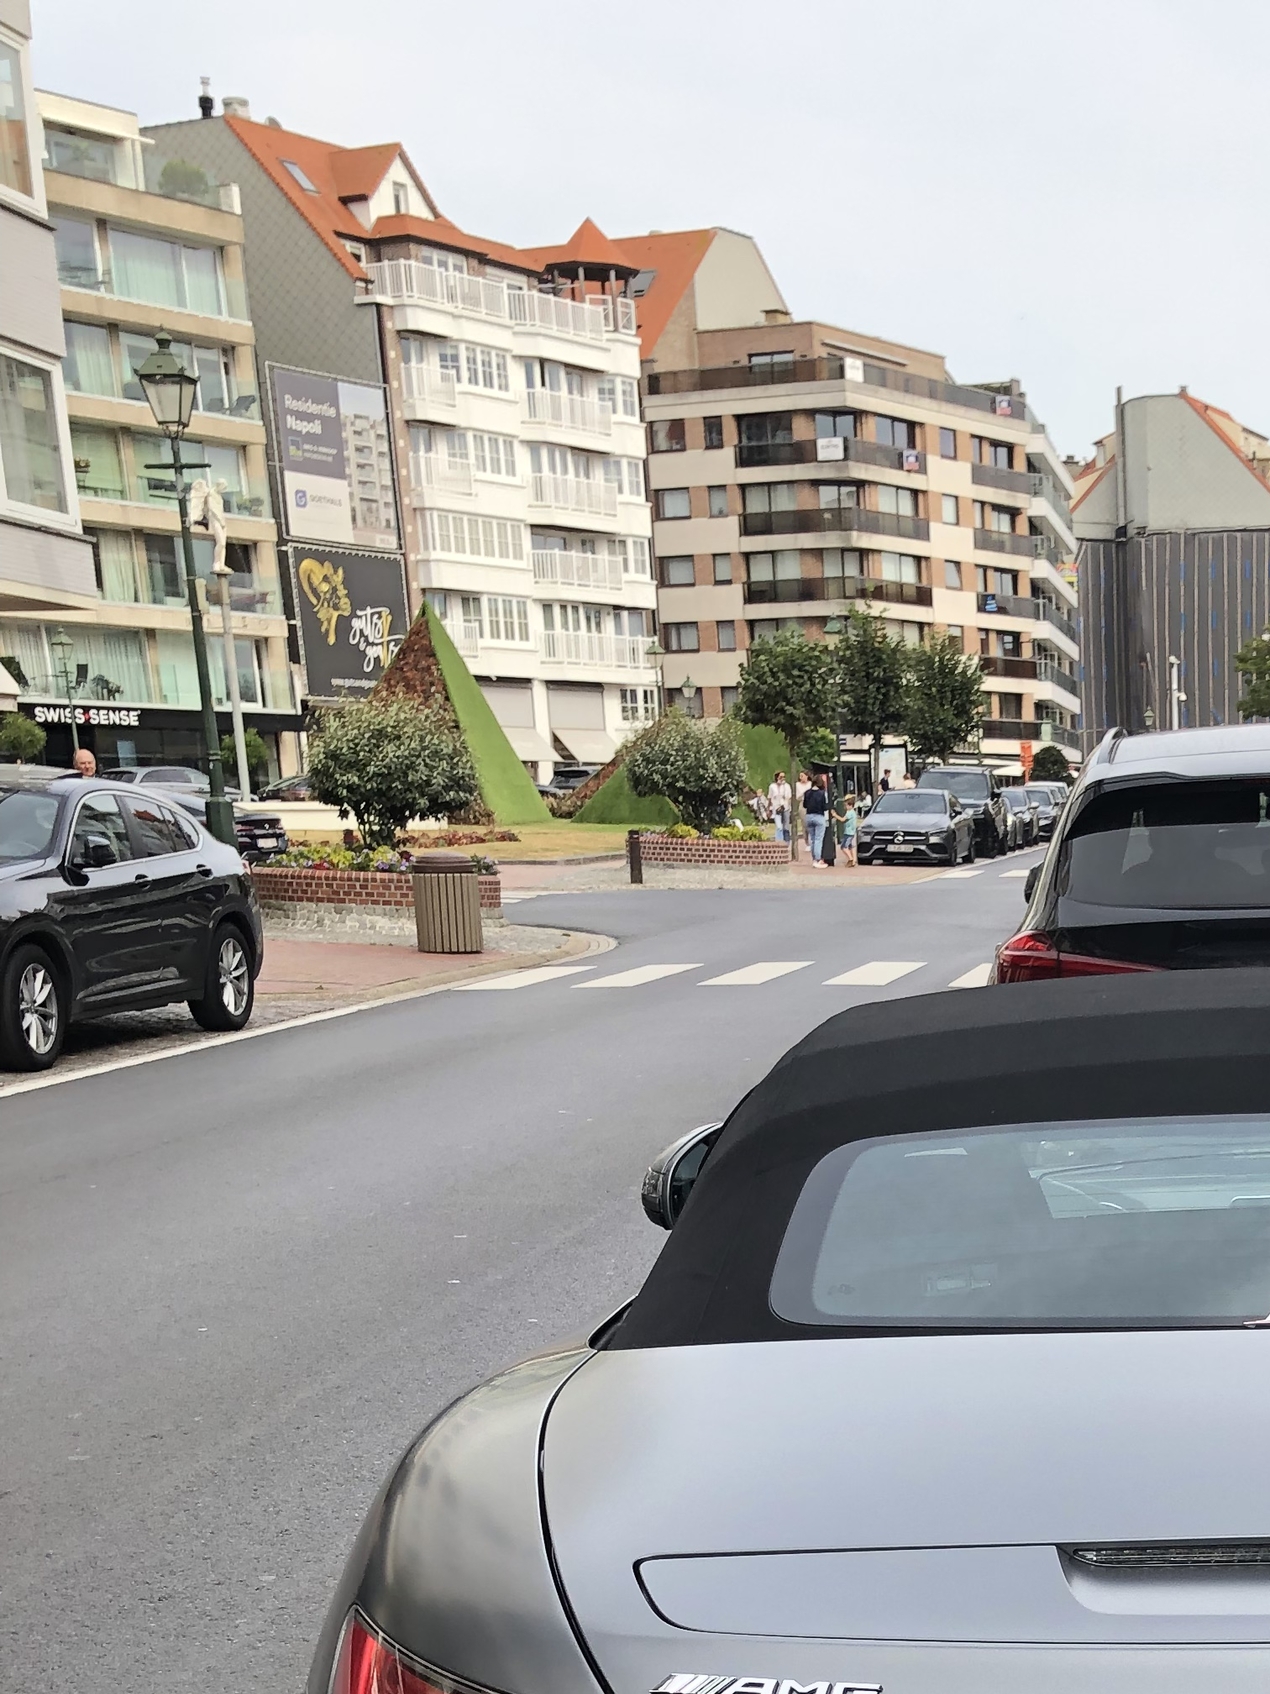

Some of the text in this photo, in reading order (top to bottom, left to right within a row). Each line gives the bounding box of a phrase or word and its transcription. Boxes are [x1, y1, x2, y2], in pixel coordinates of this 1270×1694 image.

[286, 414, 322, 435] Napoli
[34, 706, 140, 726] SWISS SENSE
